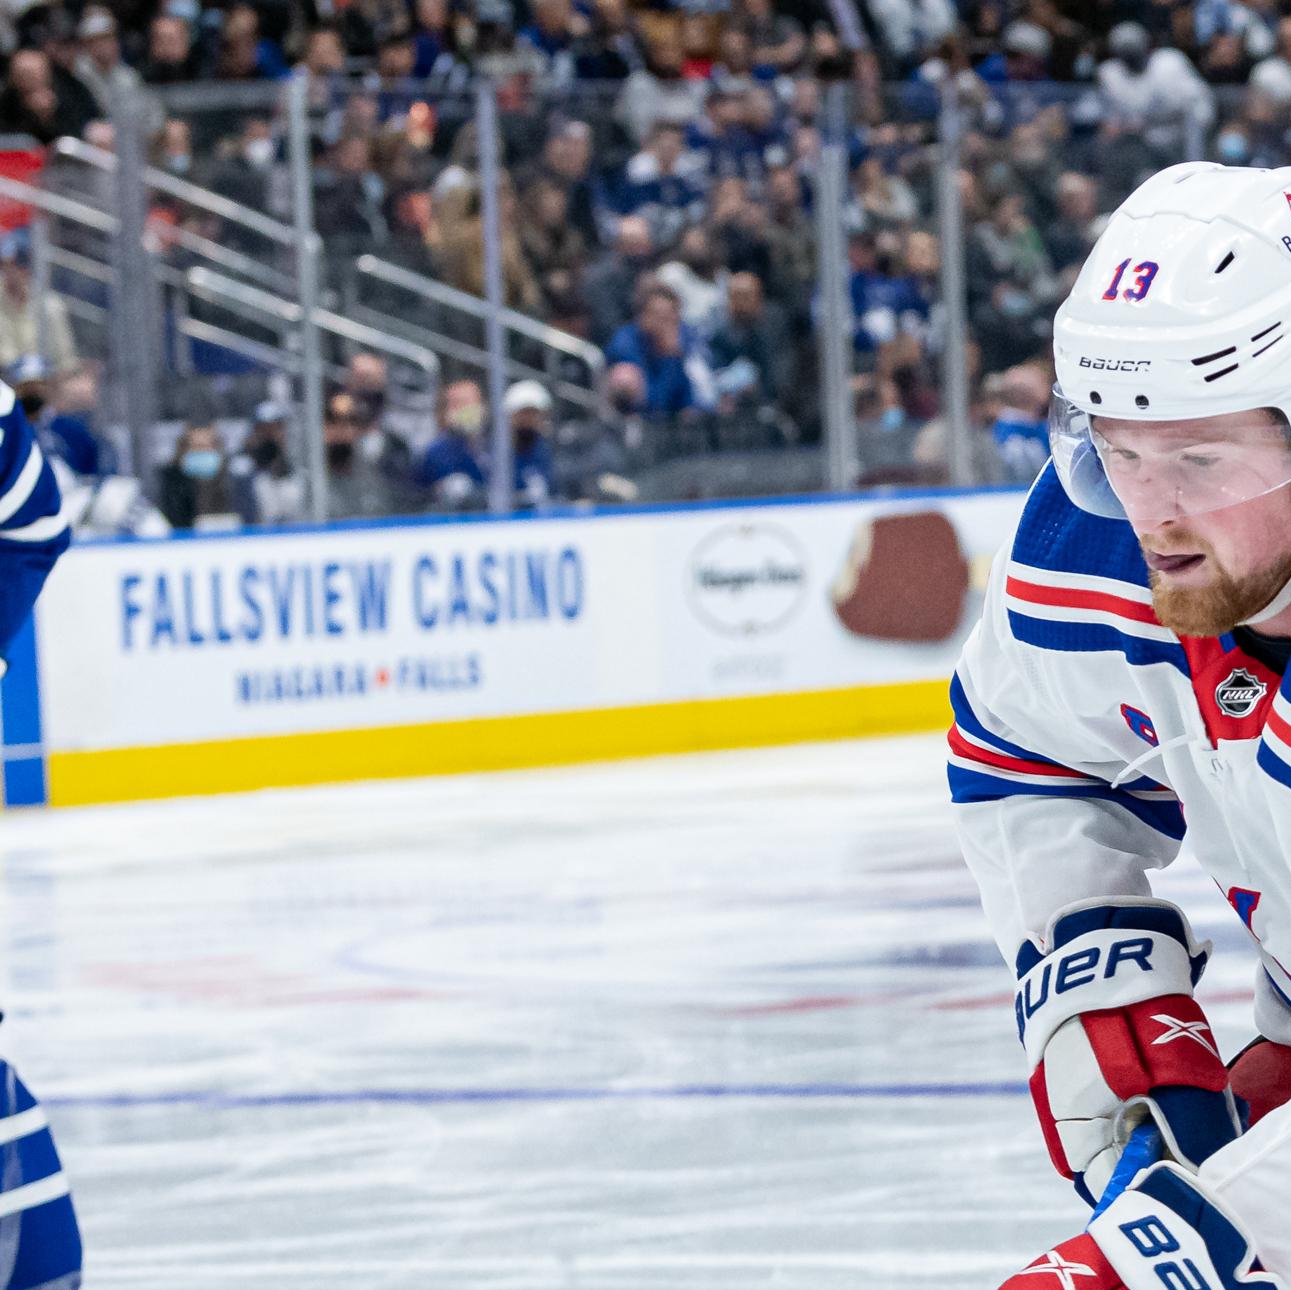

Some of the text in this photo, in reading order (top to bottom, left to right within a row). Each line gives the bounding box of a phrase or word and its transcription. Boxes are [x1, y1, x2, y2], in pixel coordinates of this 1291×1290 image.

[1102, 258, 1160, 302] 13
[121, 544, 586, 652] FALLSVIEW CASINO
[236, 652, 483, 706] NIAGARA FALLS
[1222, 689, 1255, 700] NHL
